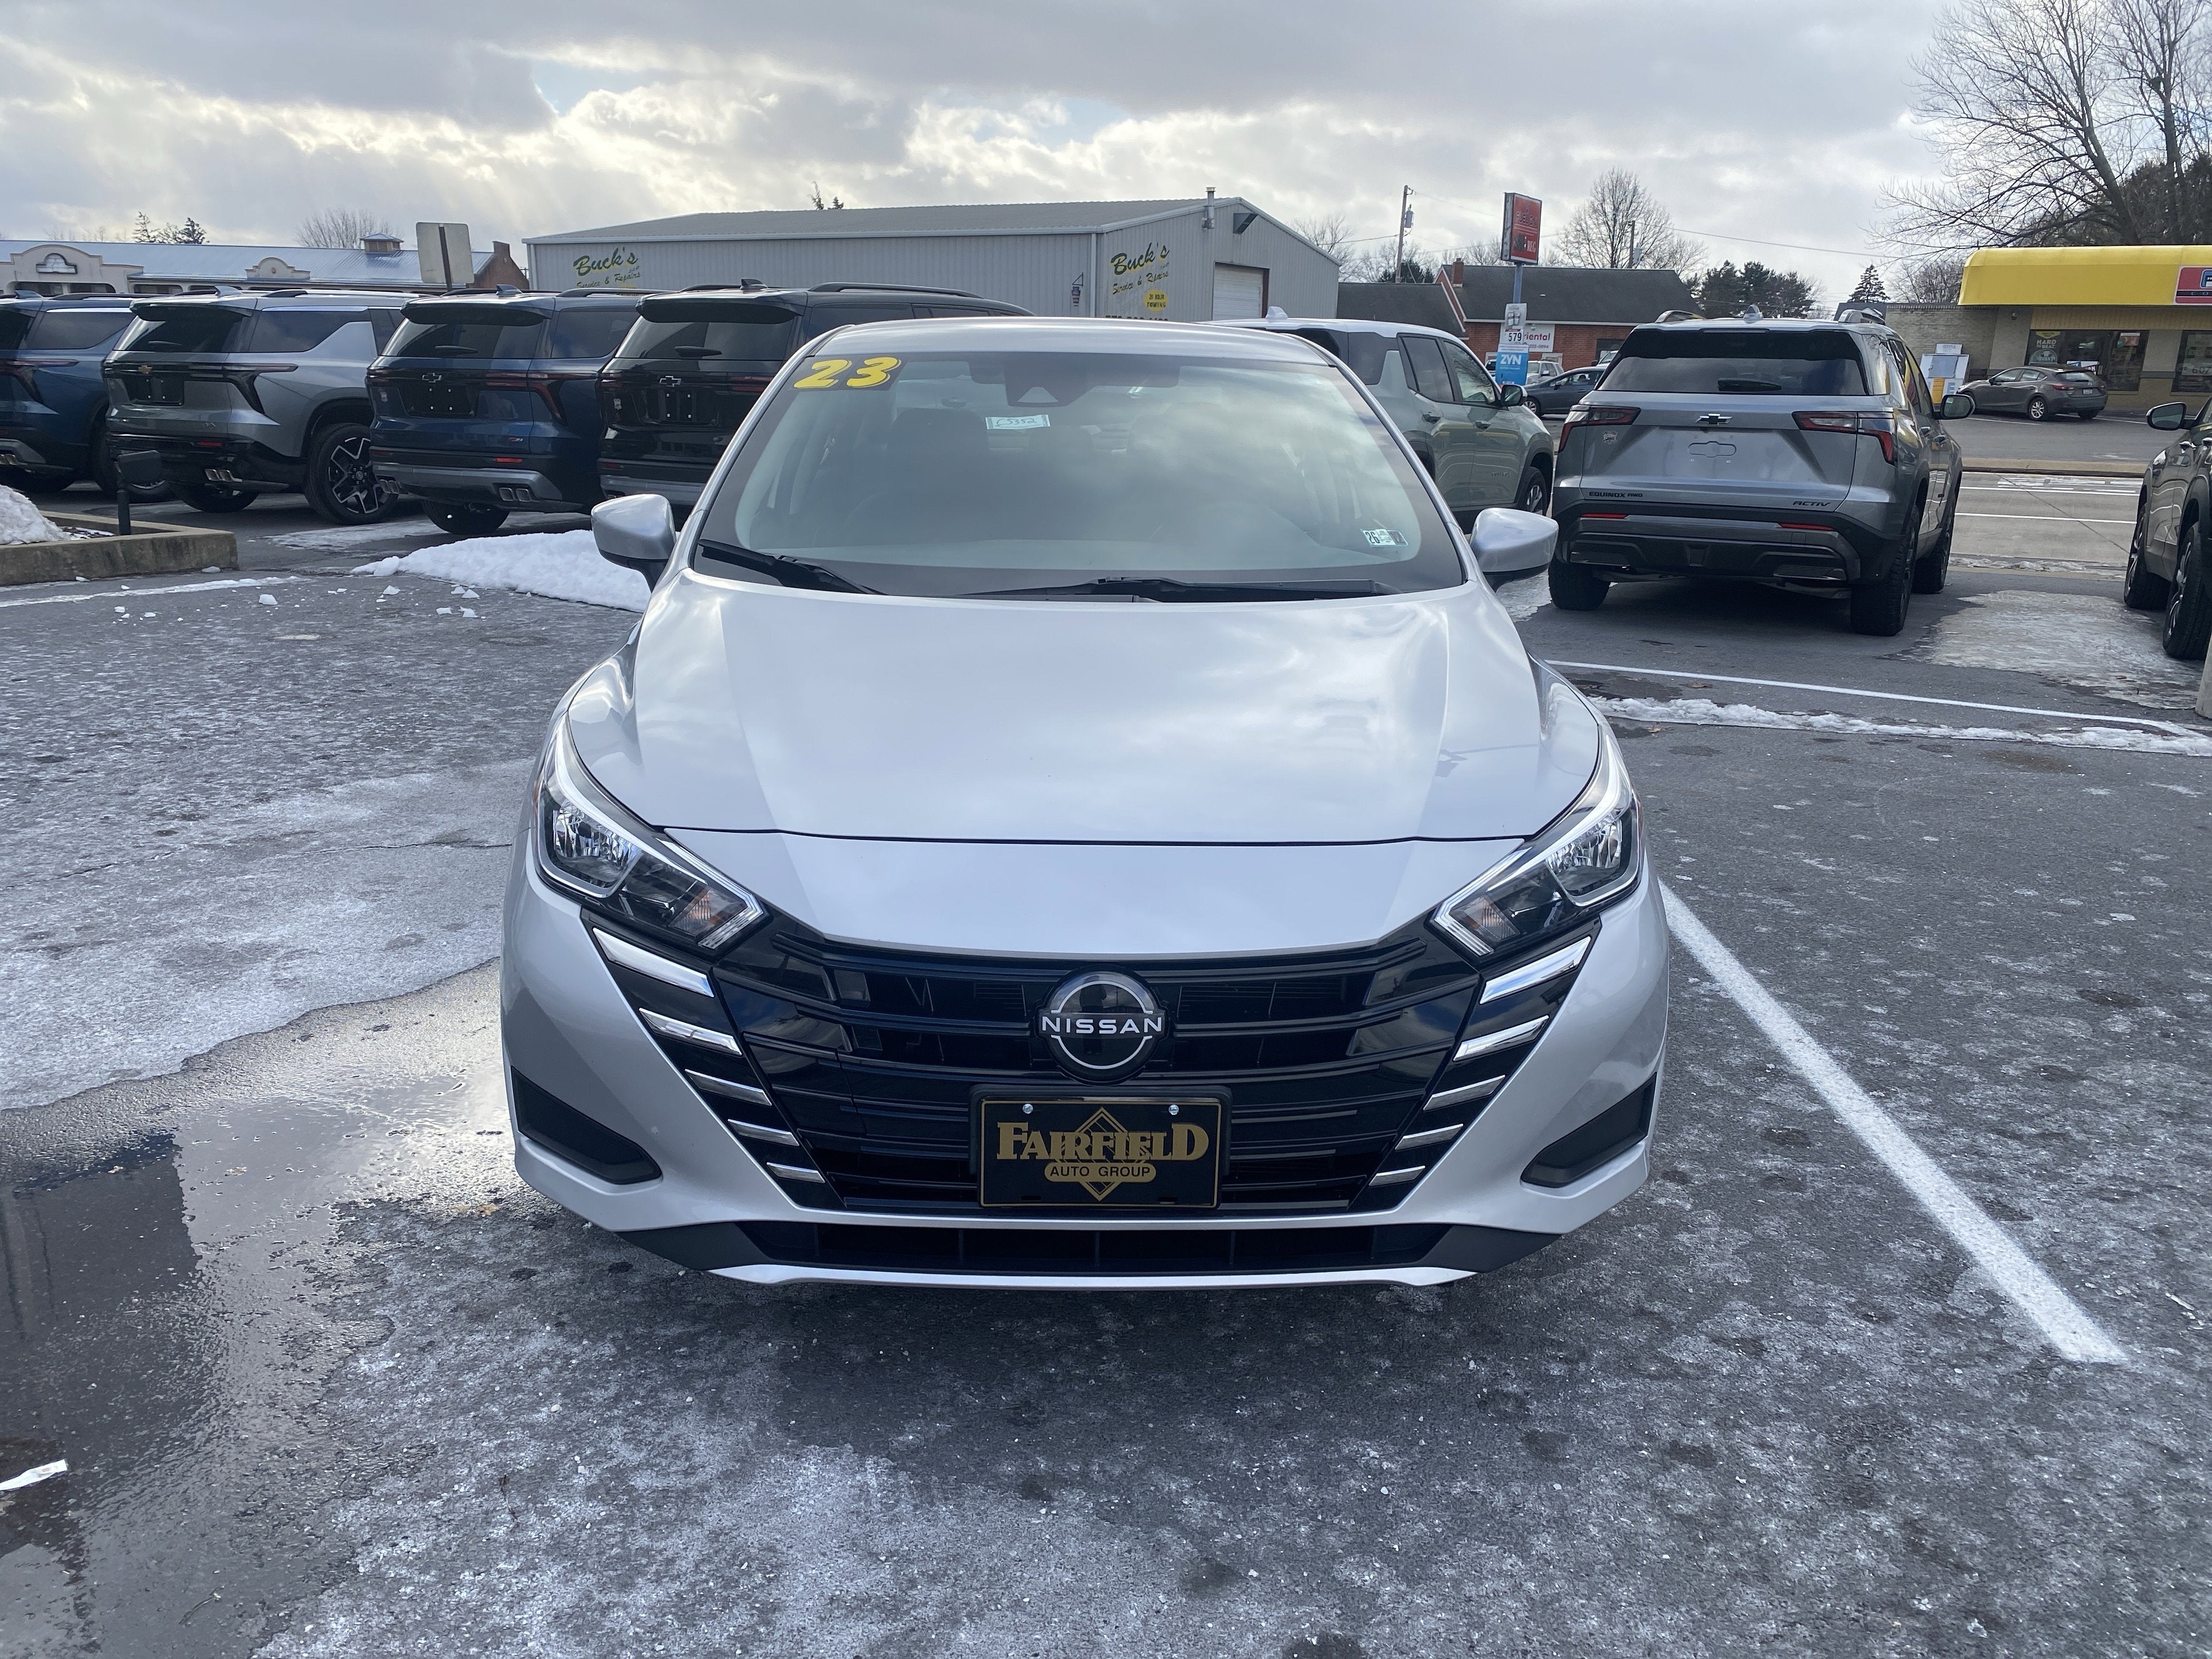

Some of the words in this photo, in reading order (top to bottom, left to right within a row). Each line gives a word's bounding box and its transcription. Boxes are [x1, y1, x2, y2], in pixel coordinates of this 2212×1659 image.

[1527, 240, 1537, 253] REG
[573, 246, 638, 276] Buck's
[1110, 242, 1170, 275] Buck's
[605, 276, 609, 284] &
[614, 272, 641, 283] Repairs
[1508, 332, 1522, 342] 579
[1500, 354, 1522, 365] ZYN
[794, 357, 902, 388] 23
[1365, 531, 1380, 544] 26
[1042, 1016, 1162, 1034] NISSAN
[997, 1121, 1209, 1161] FAIRFIELD
[1050, 1166, 1090, 1177] AUTO
[1098, 1166, 1150, 1177] GROUP
